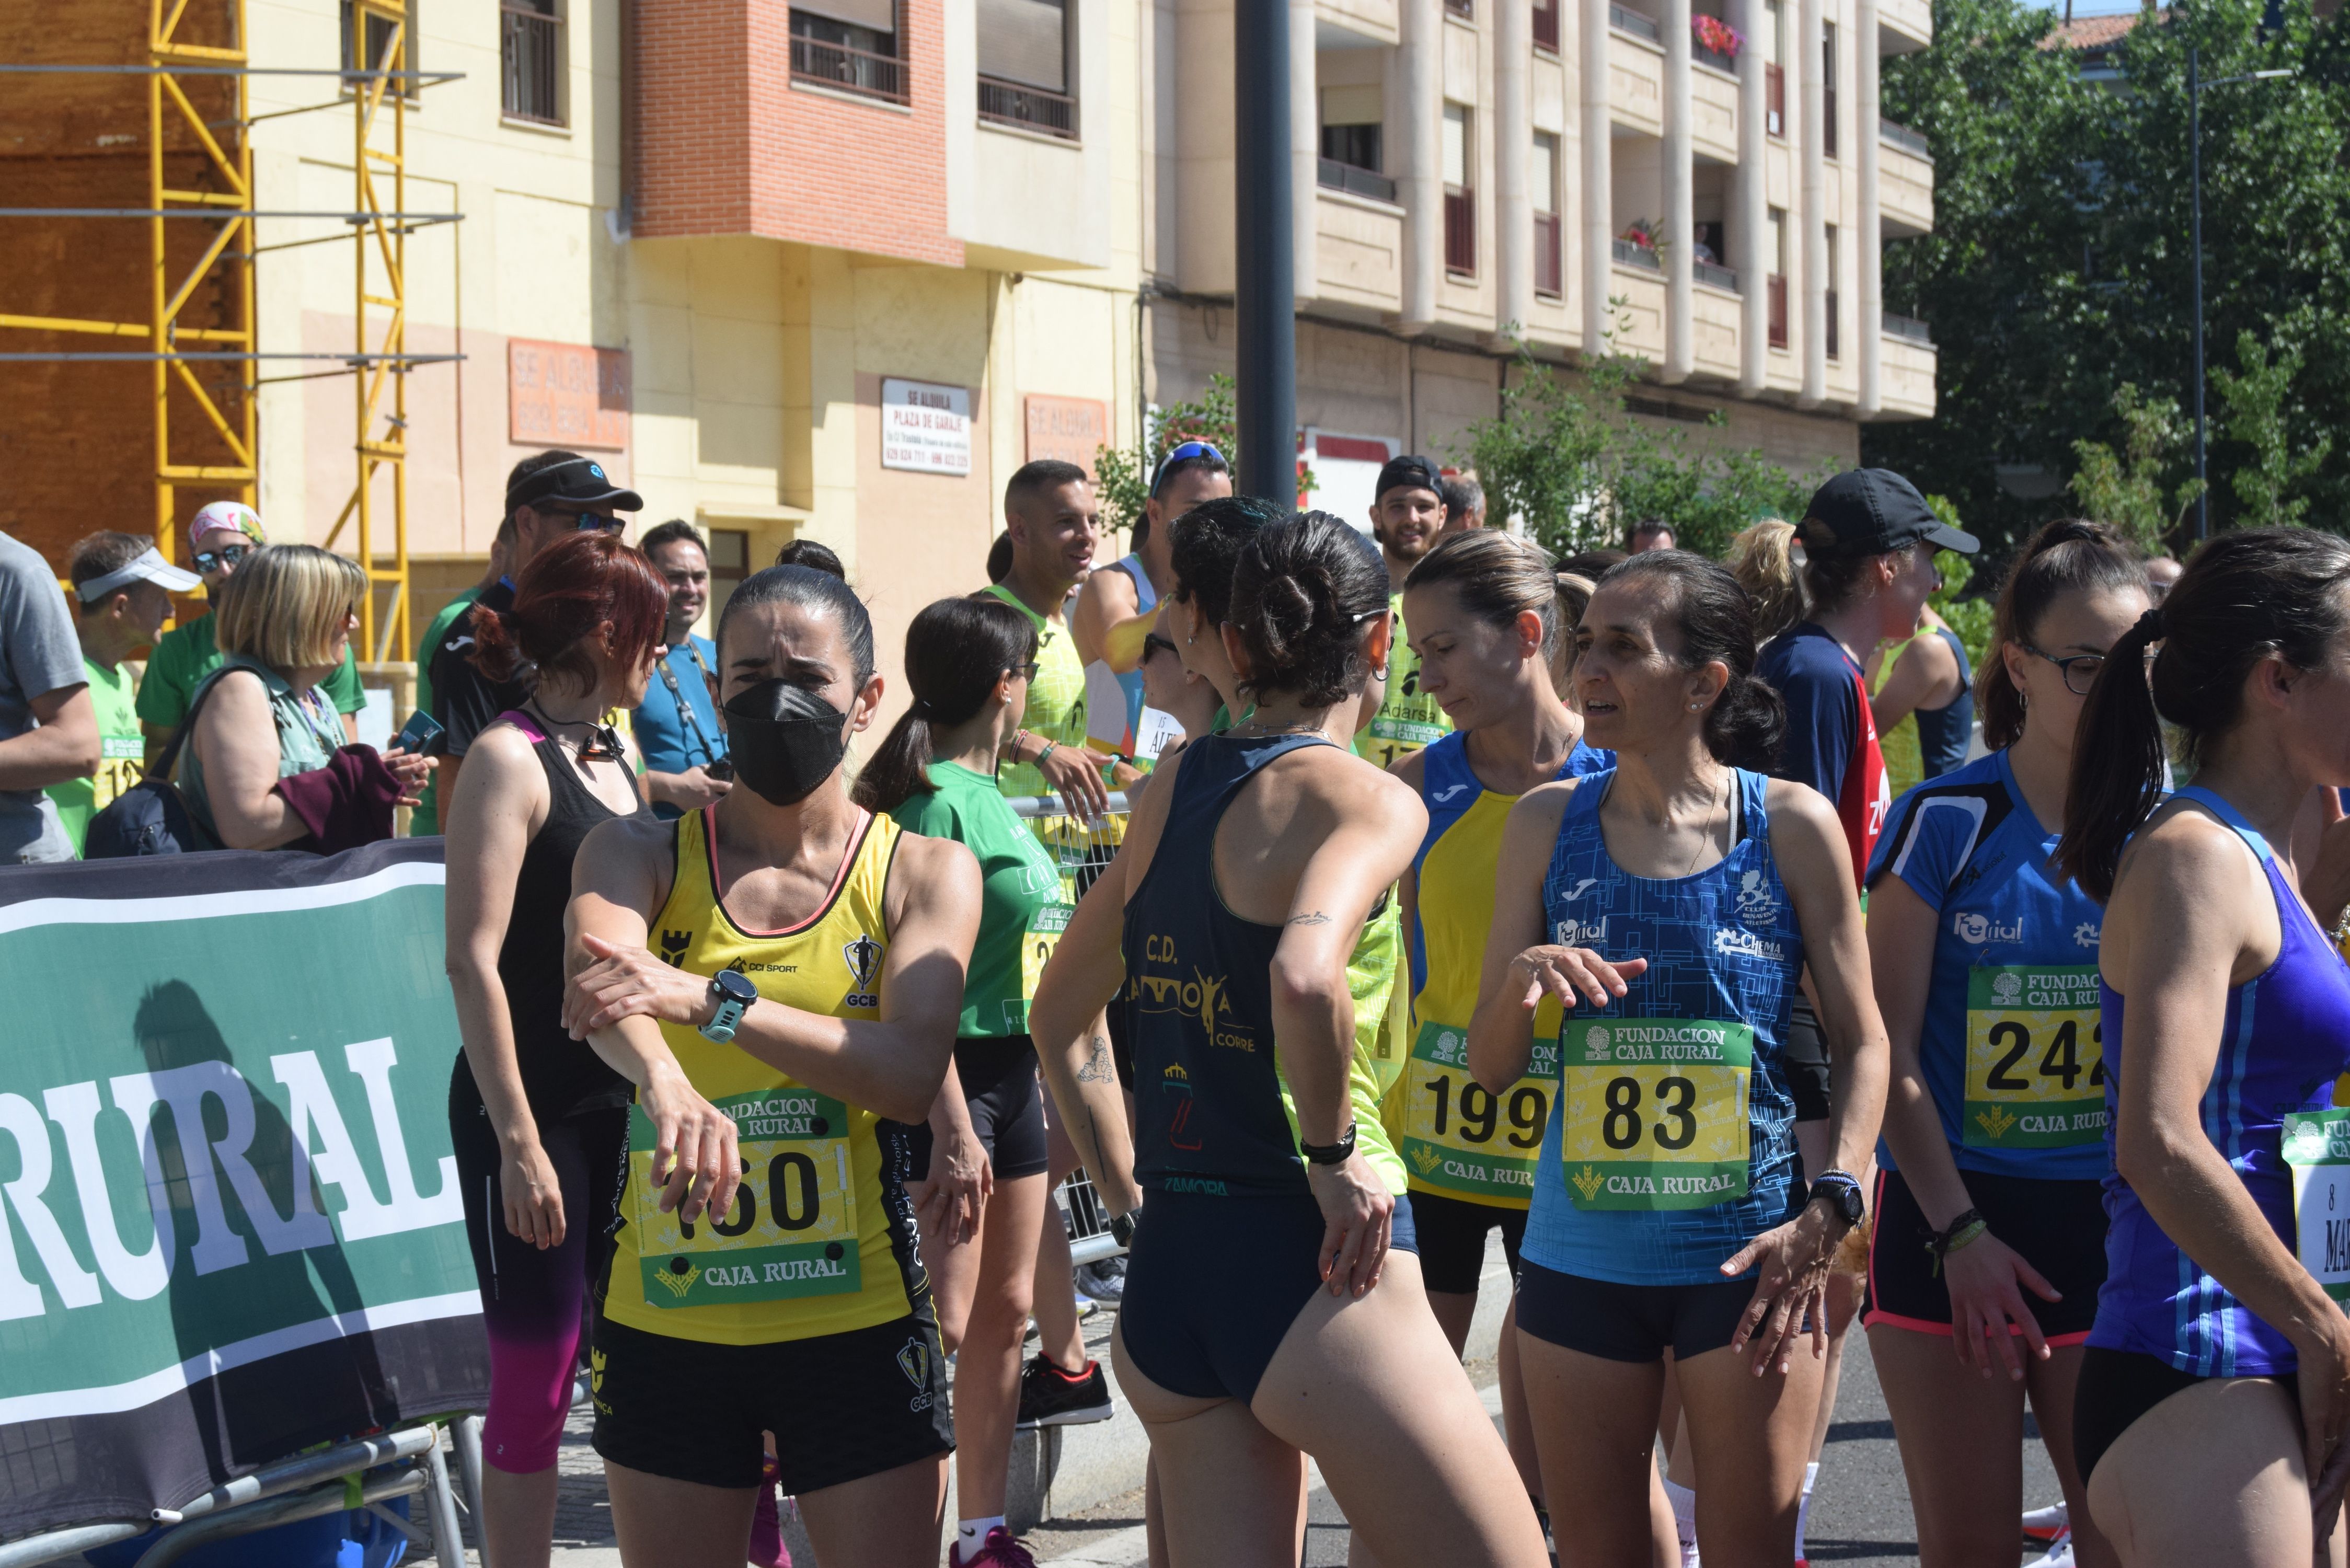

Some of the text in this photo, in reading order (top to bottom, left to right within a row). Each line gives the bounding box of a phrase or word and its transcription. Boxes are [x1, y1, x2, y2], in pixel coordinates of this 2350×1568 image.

[908, 390, 951, 410] SE ALQUILA
[894, 410, 962, 432] PLAZA DE GARAJE
[1379, 702, 1436, 723] Adarsa
[1158, 717, 1166, 728] 15
[1743, 908, 1777, 918] BENAVENTE
[1744, 916, 1777, 926] ATLETISMO
[1147, 934, 1178, 964] C.D.
[1758, 950, 1785, 959] TRANSPORTES
[749, 962, 798, 973] CCI SPORT
[846, 994, 878, 1007] GCB
[2028, 991, 2070, 1007] CAJA
[1216, 1033, 1255, 1052] CORRE
[1615, 1027, 1726, 1045] FUNDACION
[1616, 1045, 1724, 1060] CAJA RURAL
[1425, 1075, 1548, 1149] 199
[1603, 1077, 1697, 1150] 83
[2020, 1115, 2068, 1133] CAJA
[0, 1036, 466, 1321] RURAL
[1444, 1160, 1536, 1186] CAJA RUR
[1607, 1173, 1735, 1195] CAJA RURAL
[2329, 1184, 2335, 1210] 8
[705, 1259, 846, 1287] CAJA RURAL
[912, 1393, 932, 1410] GCB
